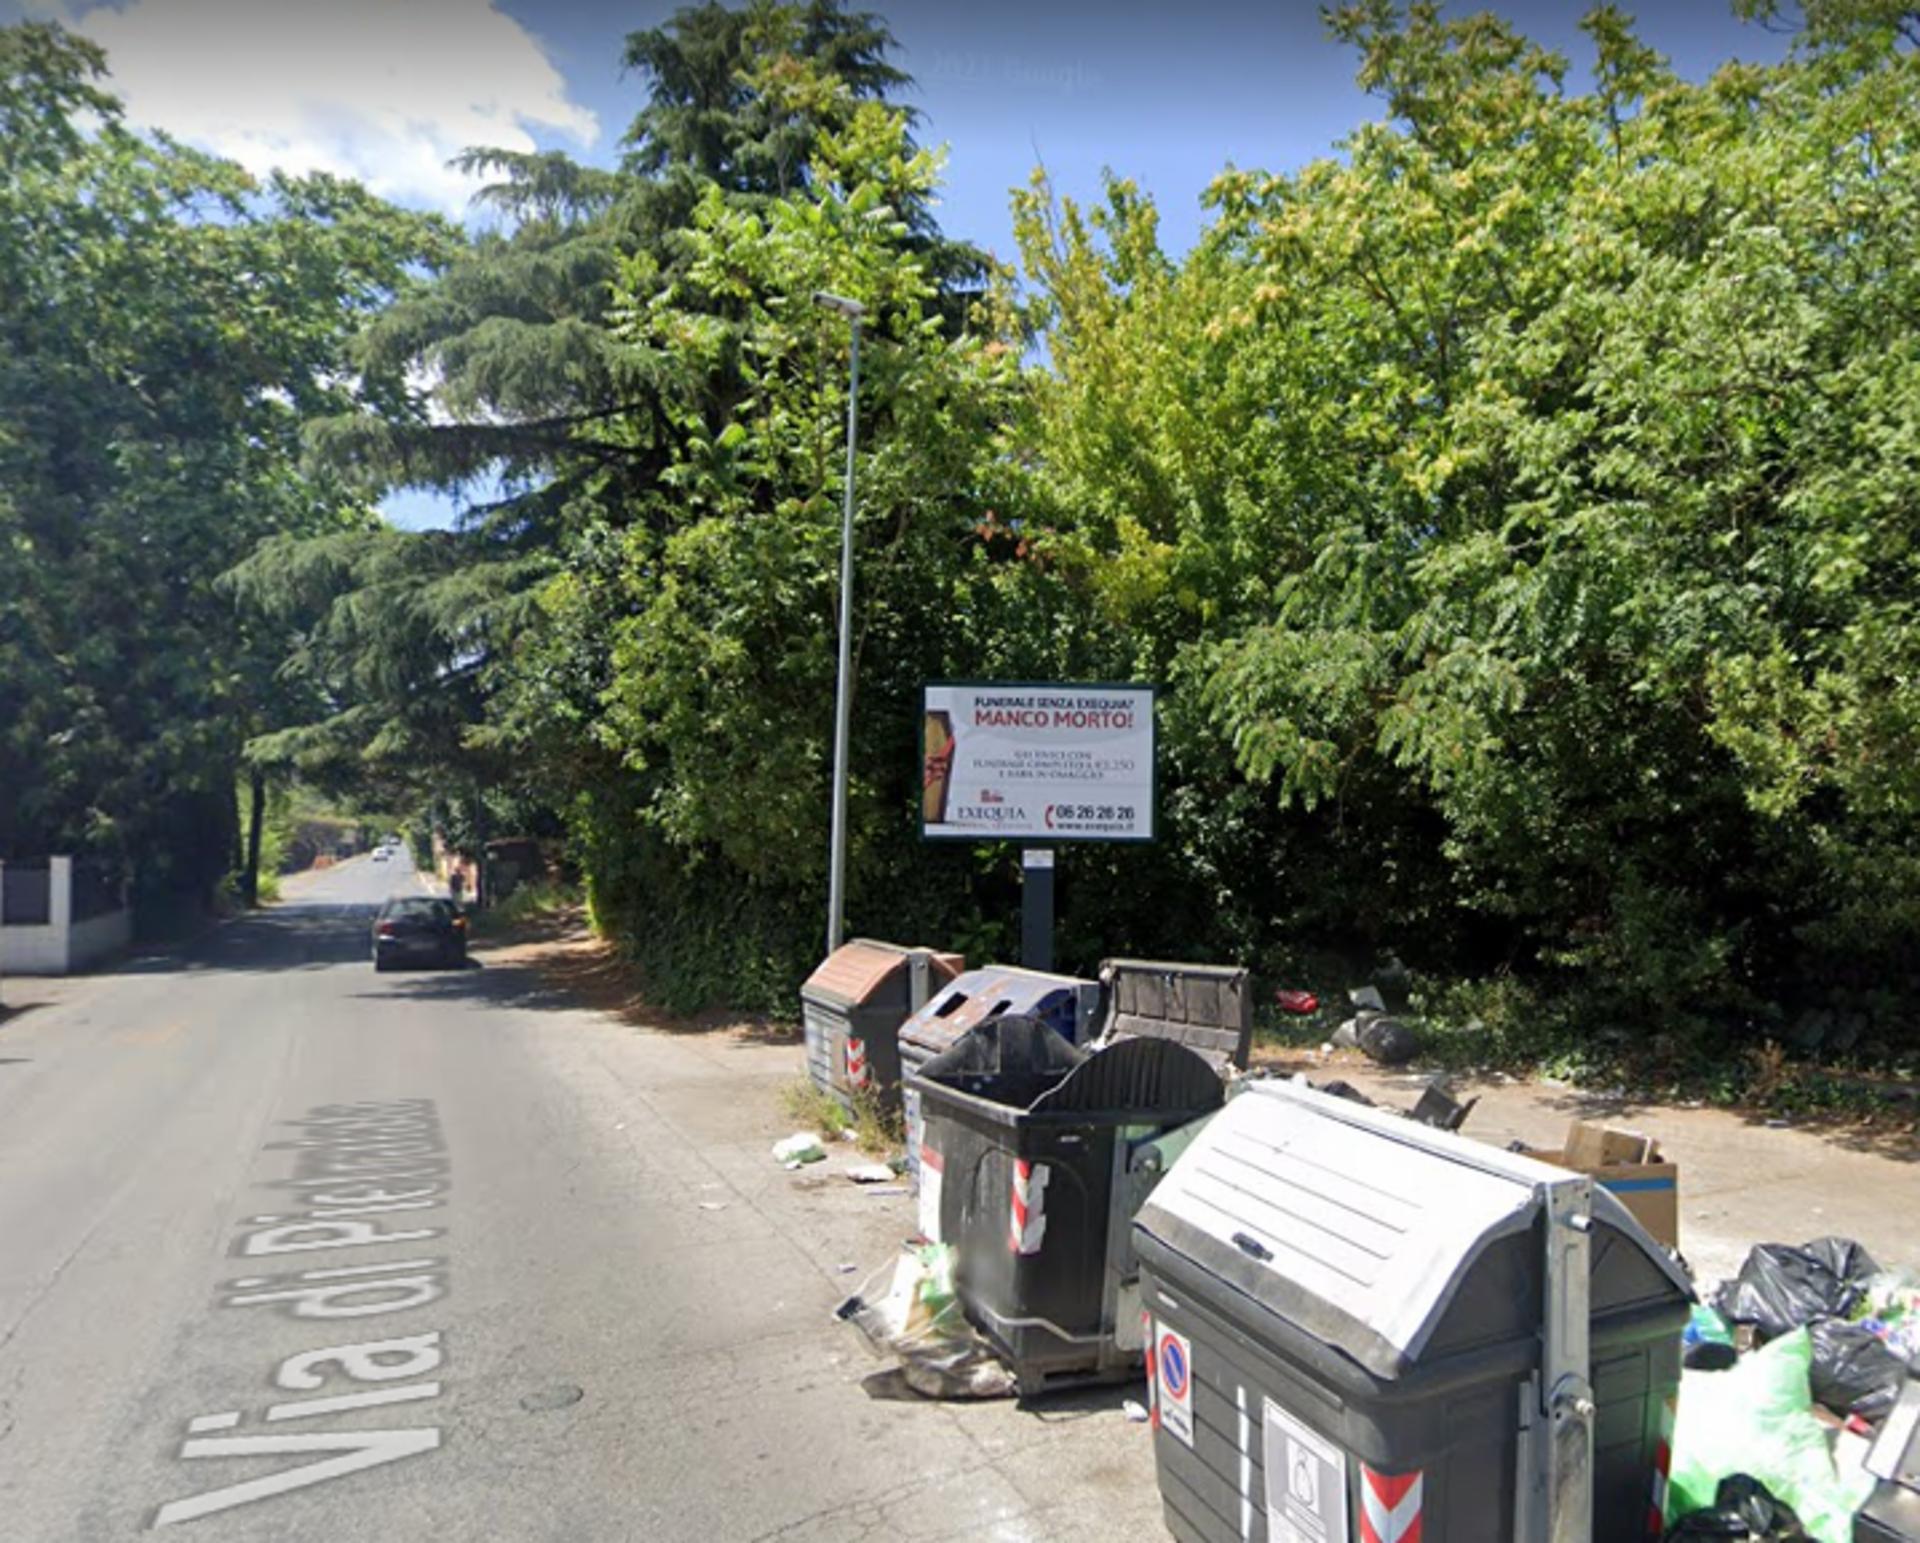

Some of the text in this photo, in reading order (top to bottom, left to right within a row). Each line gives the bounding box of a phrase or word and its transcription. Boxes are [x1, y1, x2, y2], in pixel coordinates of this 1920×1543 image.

[974, 697, 1035, 708] FUNERALE
[1037, 698, 1075, 709] SENZA
[975, 710, 1135, 729] MANCO MORTO!
[958, 806, 1026, 821] EXEQUIA
[1077, 805, 1095, 820] 26
